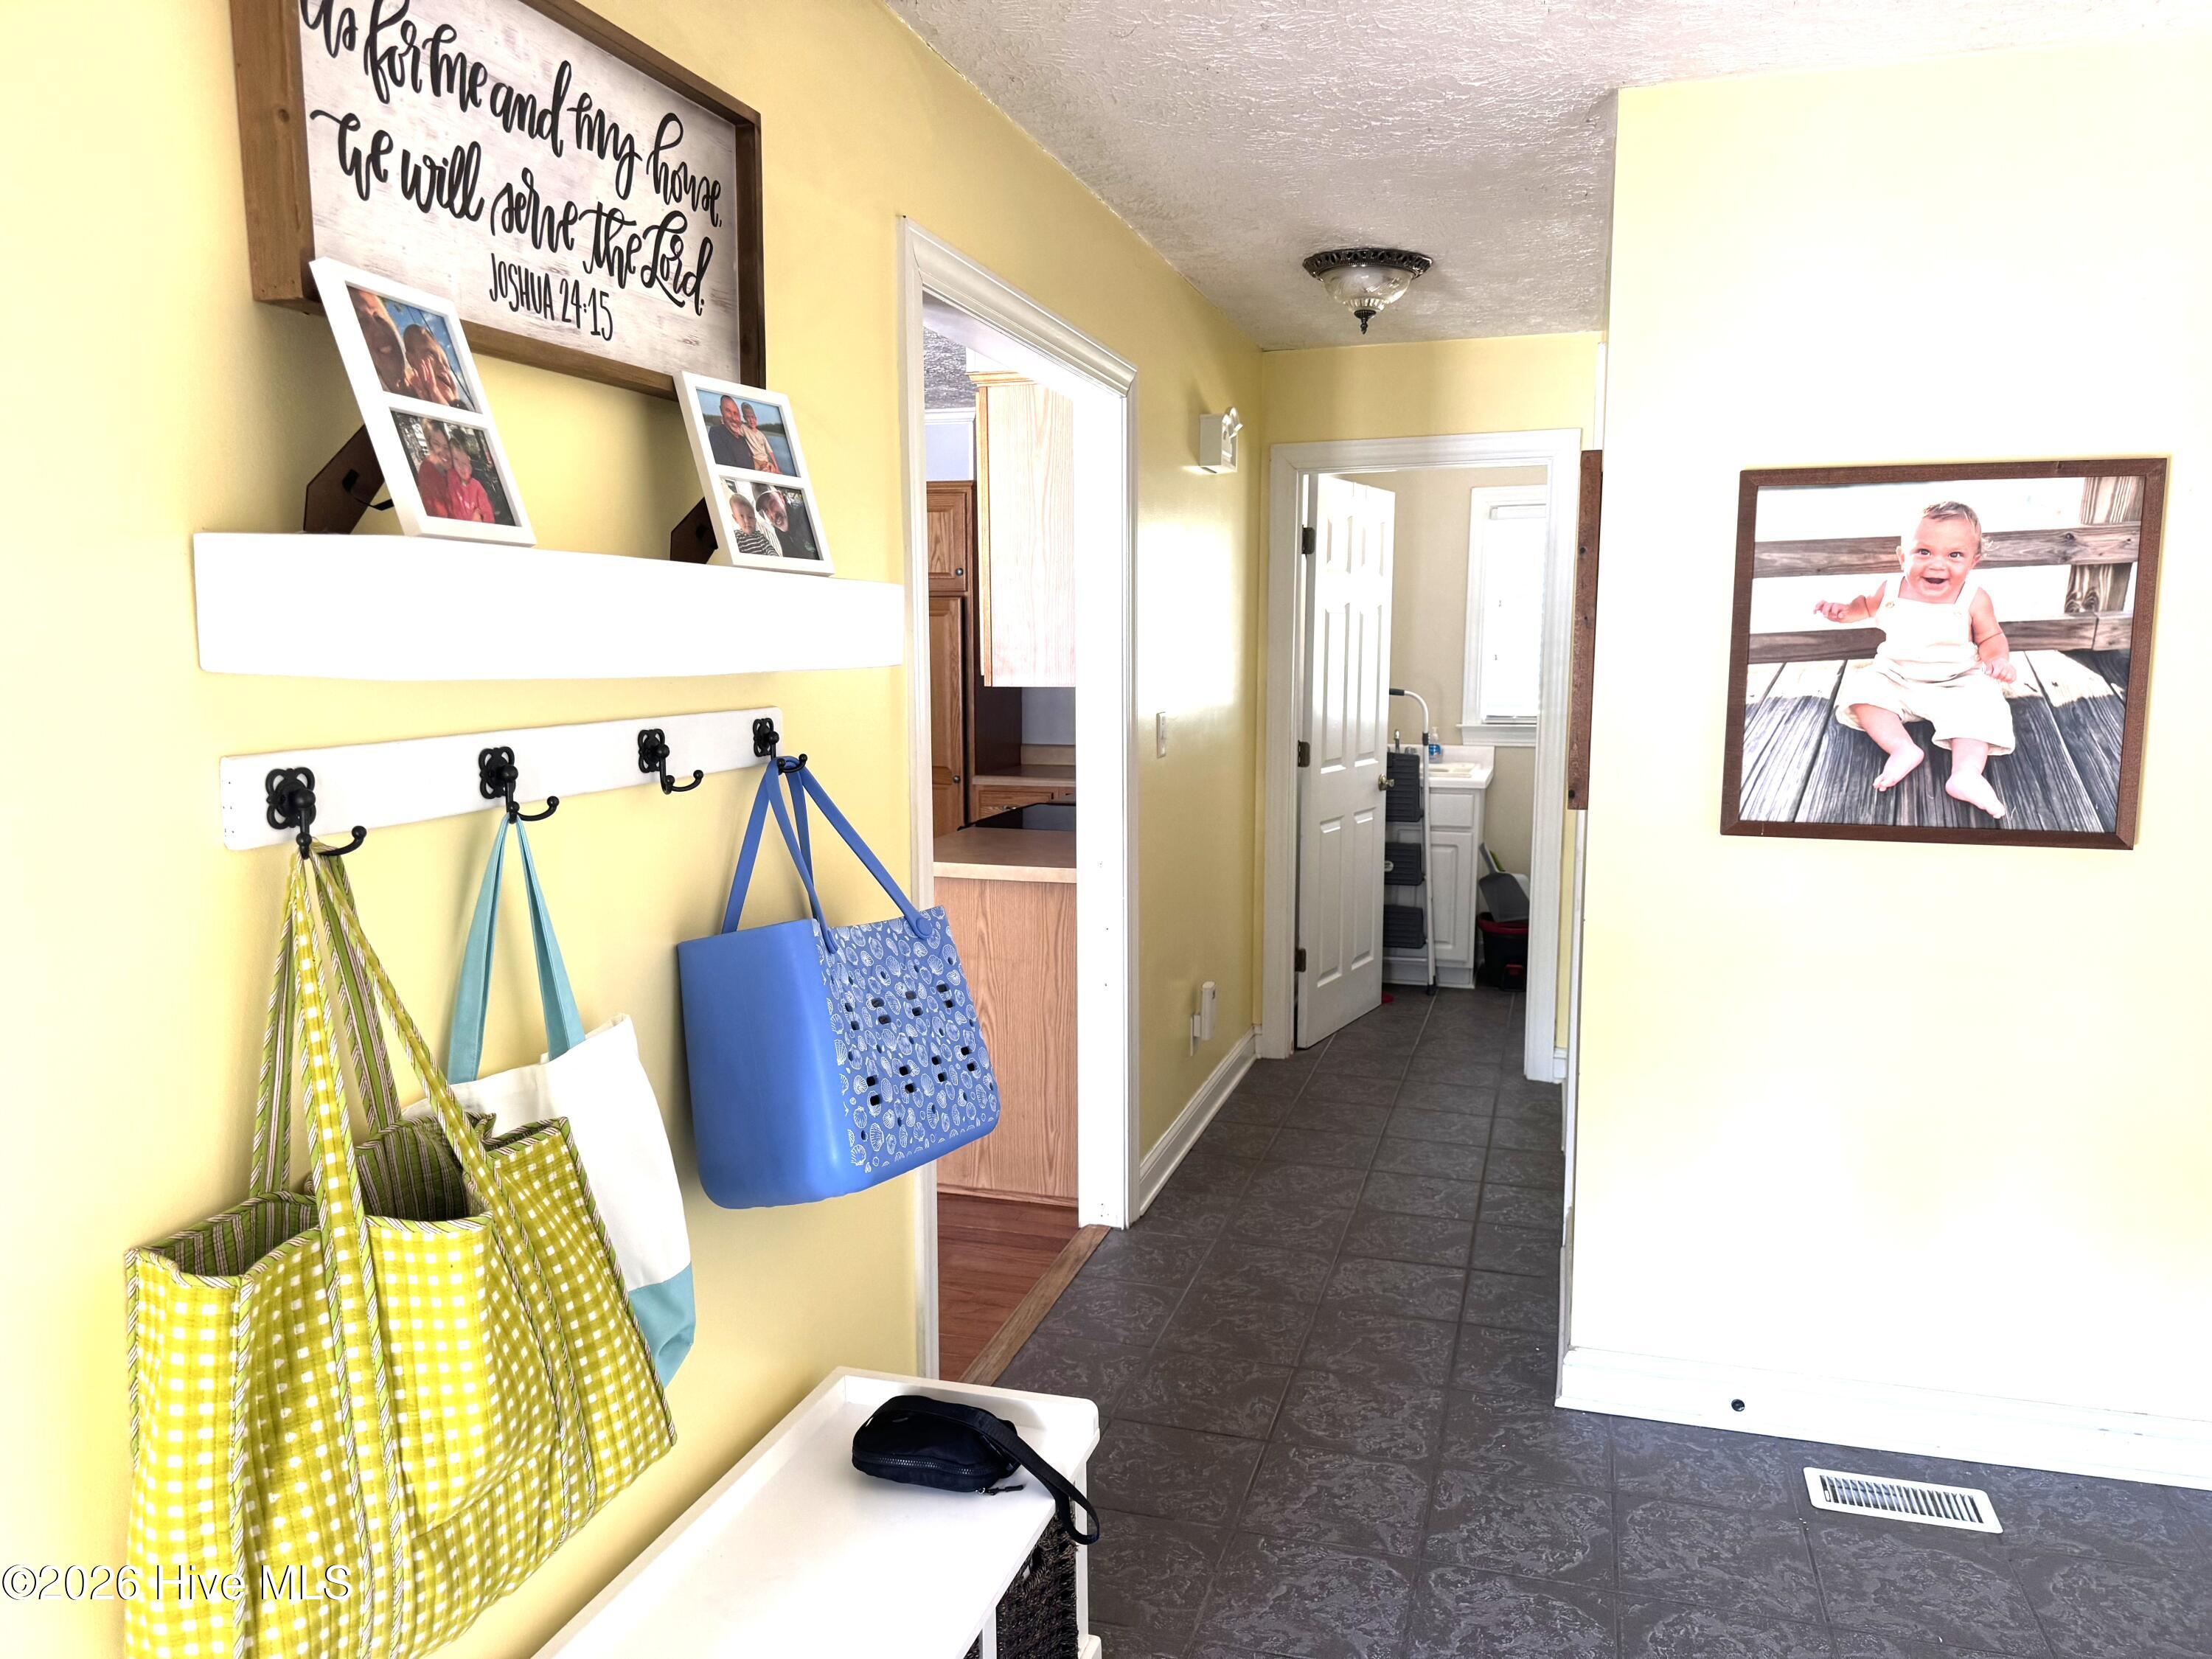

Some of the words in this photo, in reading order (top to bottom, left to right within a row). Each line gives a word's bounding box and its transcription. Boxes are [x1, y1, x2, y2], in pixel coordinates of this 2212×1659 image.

[364, 0, 422, 105] for
[422, 24, 488, 113] me
[490, 60, 572, 158] and
[566, 92, 643, 201] my
[400, 141, 485, 222] will
[490, 167, 578, 253] serve
[578, 201, 643, 290] the
[640, 210, 714, 316] Lord.
[489, 252, 555, 321] JOSHUA
[559, 278, 613, 341] 24:15
